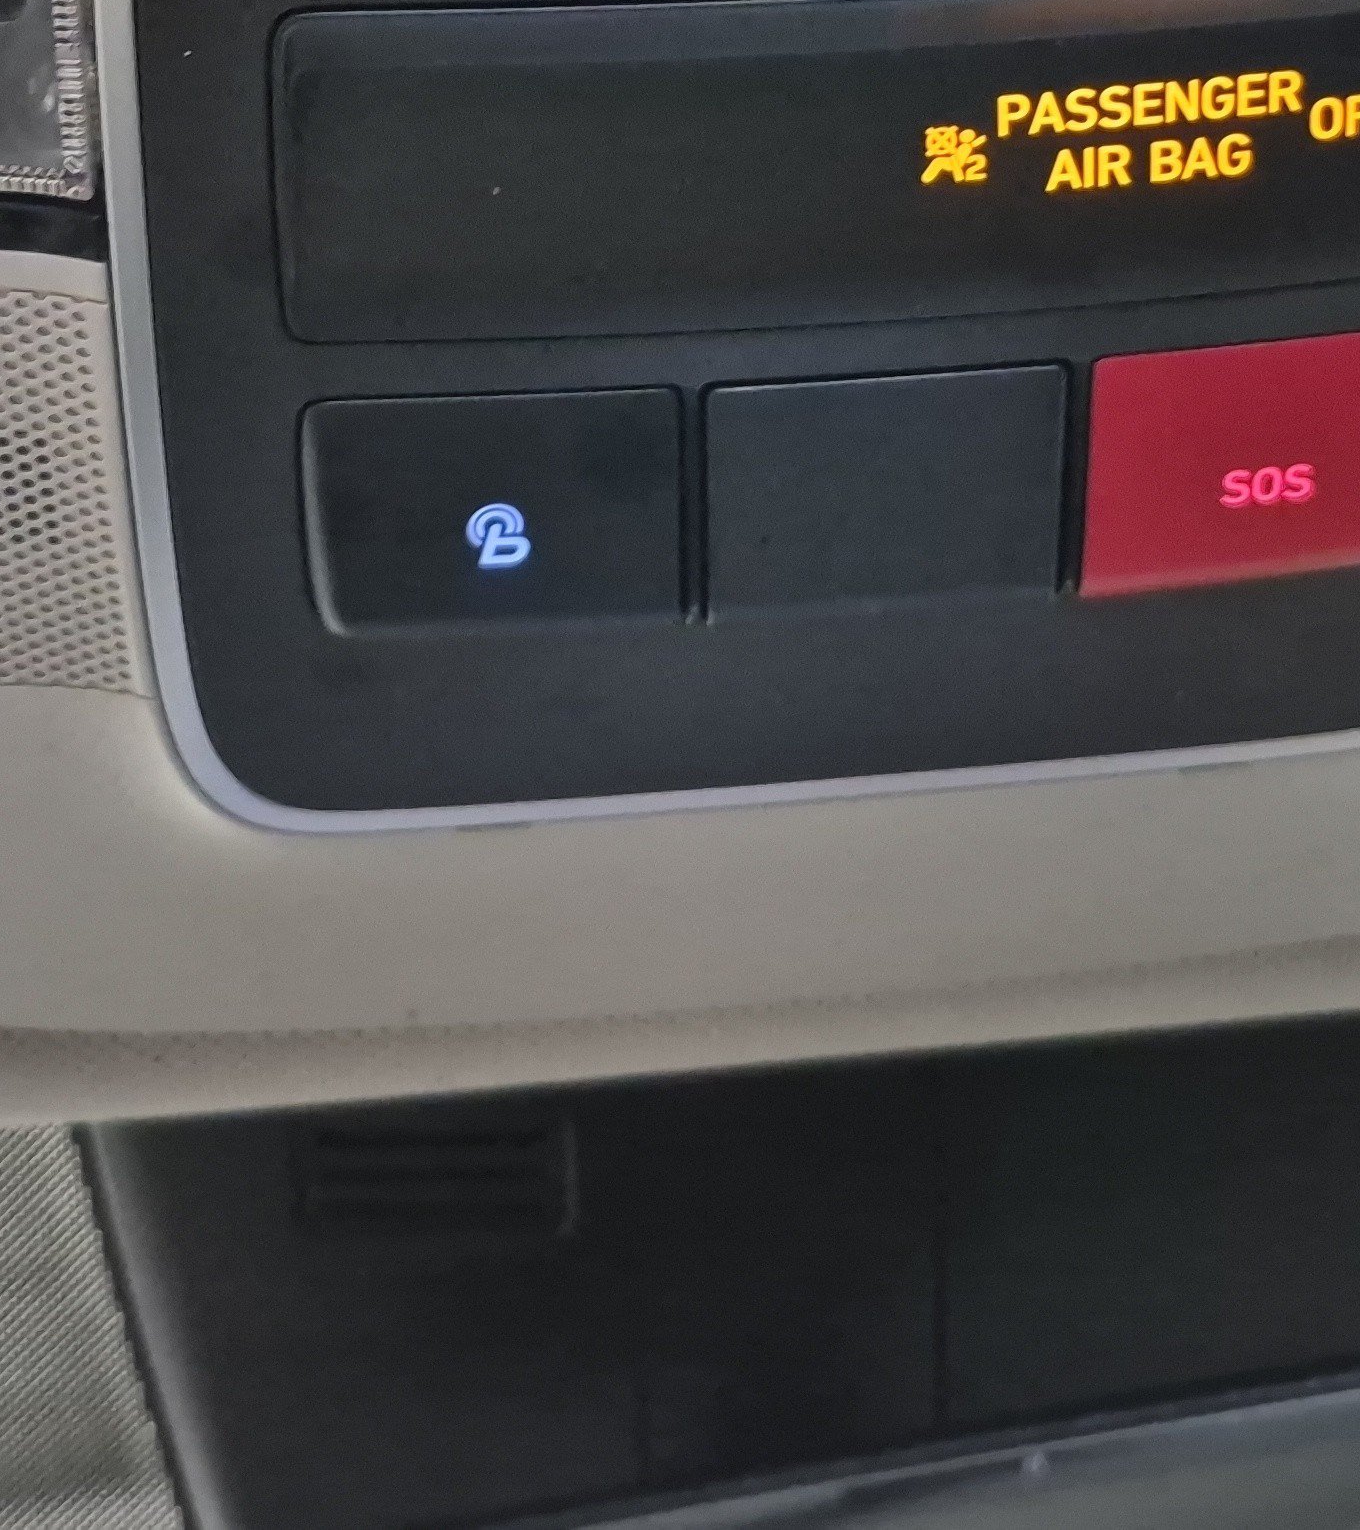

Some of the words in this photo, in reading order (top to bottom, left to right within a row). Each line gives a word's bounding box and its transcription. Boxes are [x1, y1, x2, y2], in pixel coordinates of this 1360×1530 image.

[996, 69, 1304, 138] PASSENGER
[1045, 143, 1133, 193] AIR
[1149, 132, 1254, 185] BAG
[1219, 463, 1315, 508] SOS
